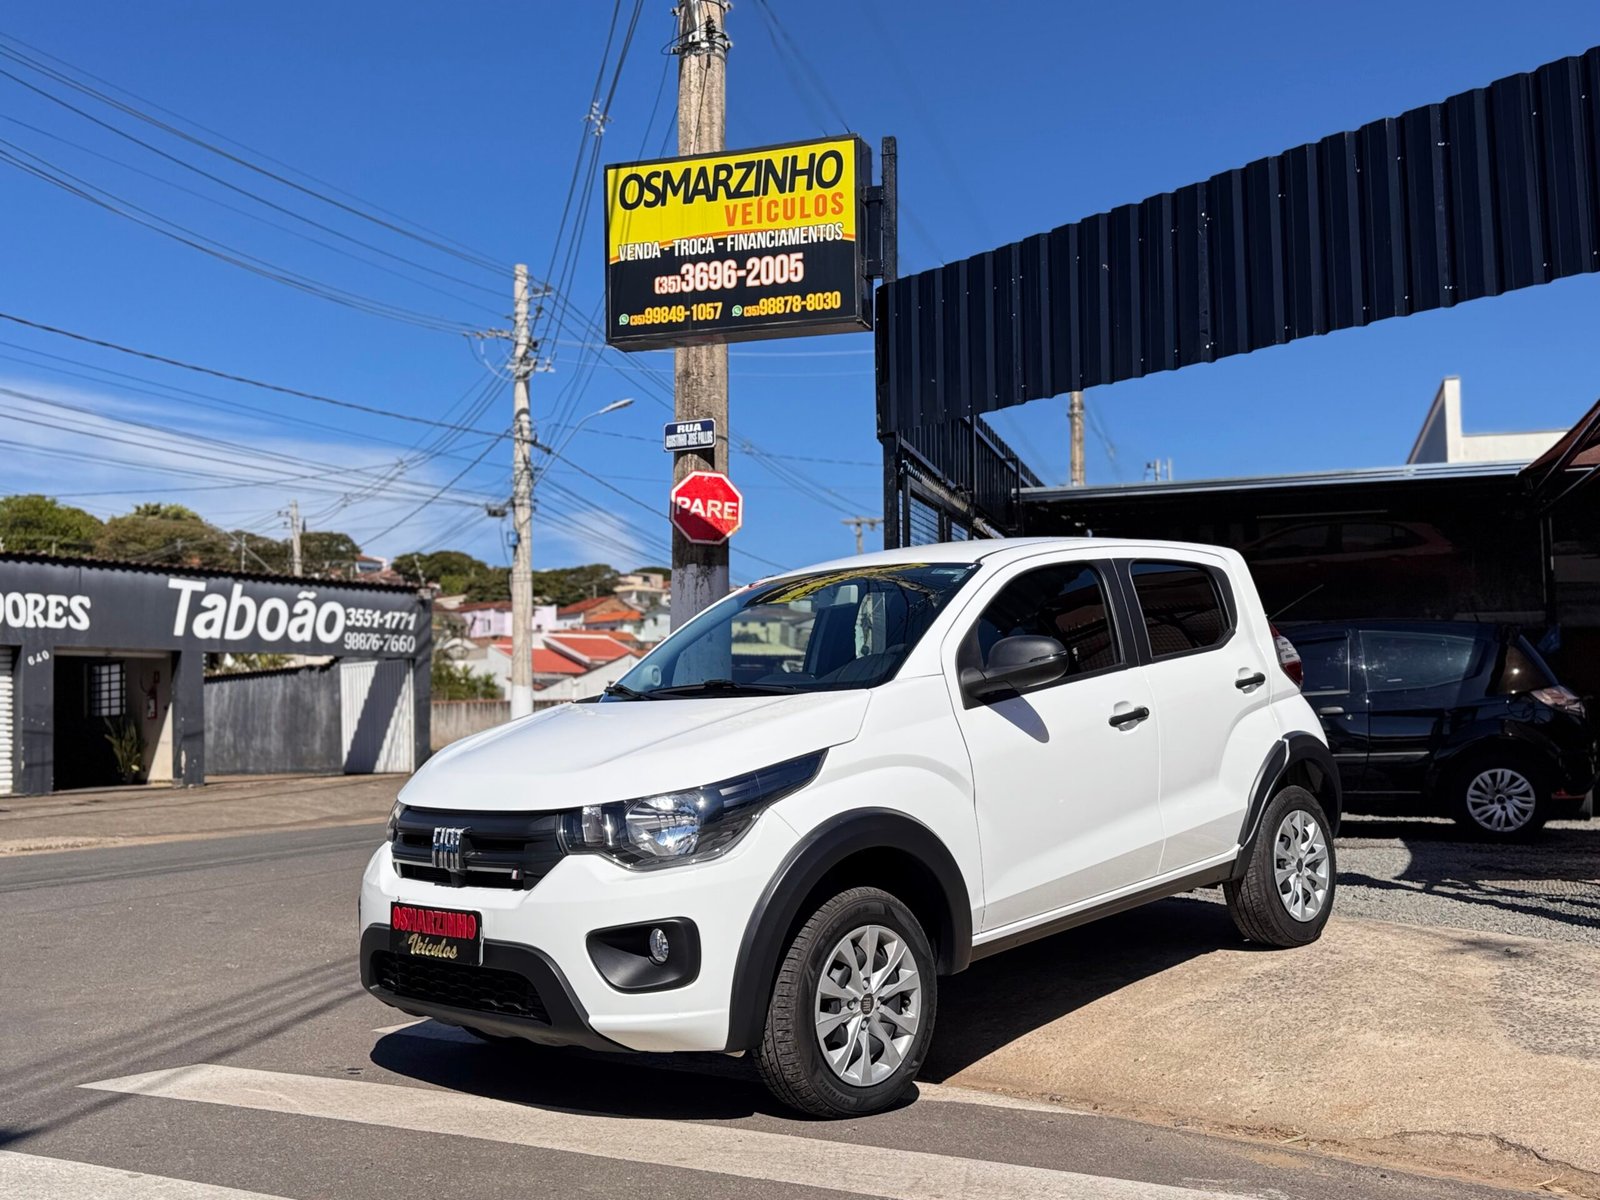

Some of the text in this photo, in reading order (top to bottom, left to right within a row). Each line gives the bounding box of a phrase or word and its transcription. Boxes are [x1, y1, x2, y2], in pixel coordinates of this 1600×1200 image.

[619, 150, 844, 210] OSMARZINHO
[724, 191, 844, 227] VEÍCULOS
[618, 242, 661, 262] VENDA
[673, 236, 715, 257] TROCA
[726, 222, 844, 252] FINANCIAMENTOS
[676, 423, 702, 434] RUA
[676, 496, 737, 520] PARE
[0, 592, 91, 631] ORES
[168, 578, 346, 644] Taboão
[393, 905, 477, 940] OSMARZINHO
